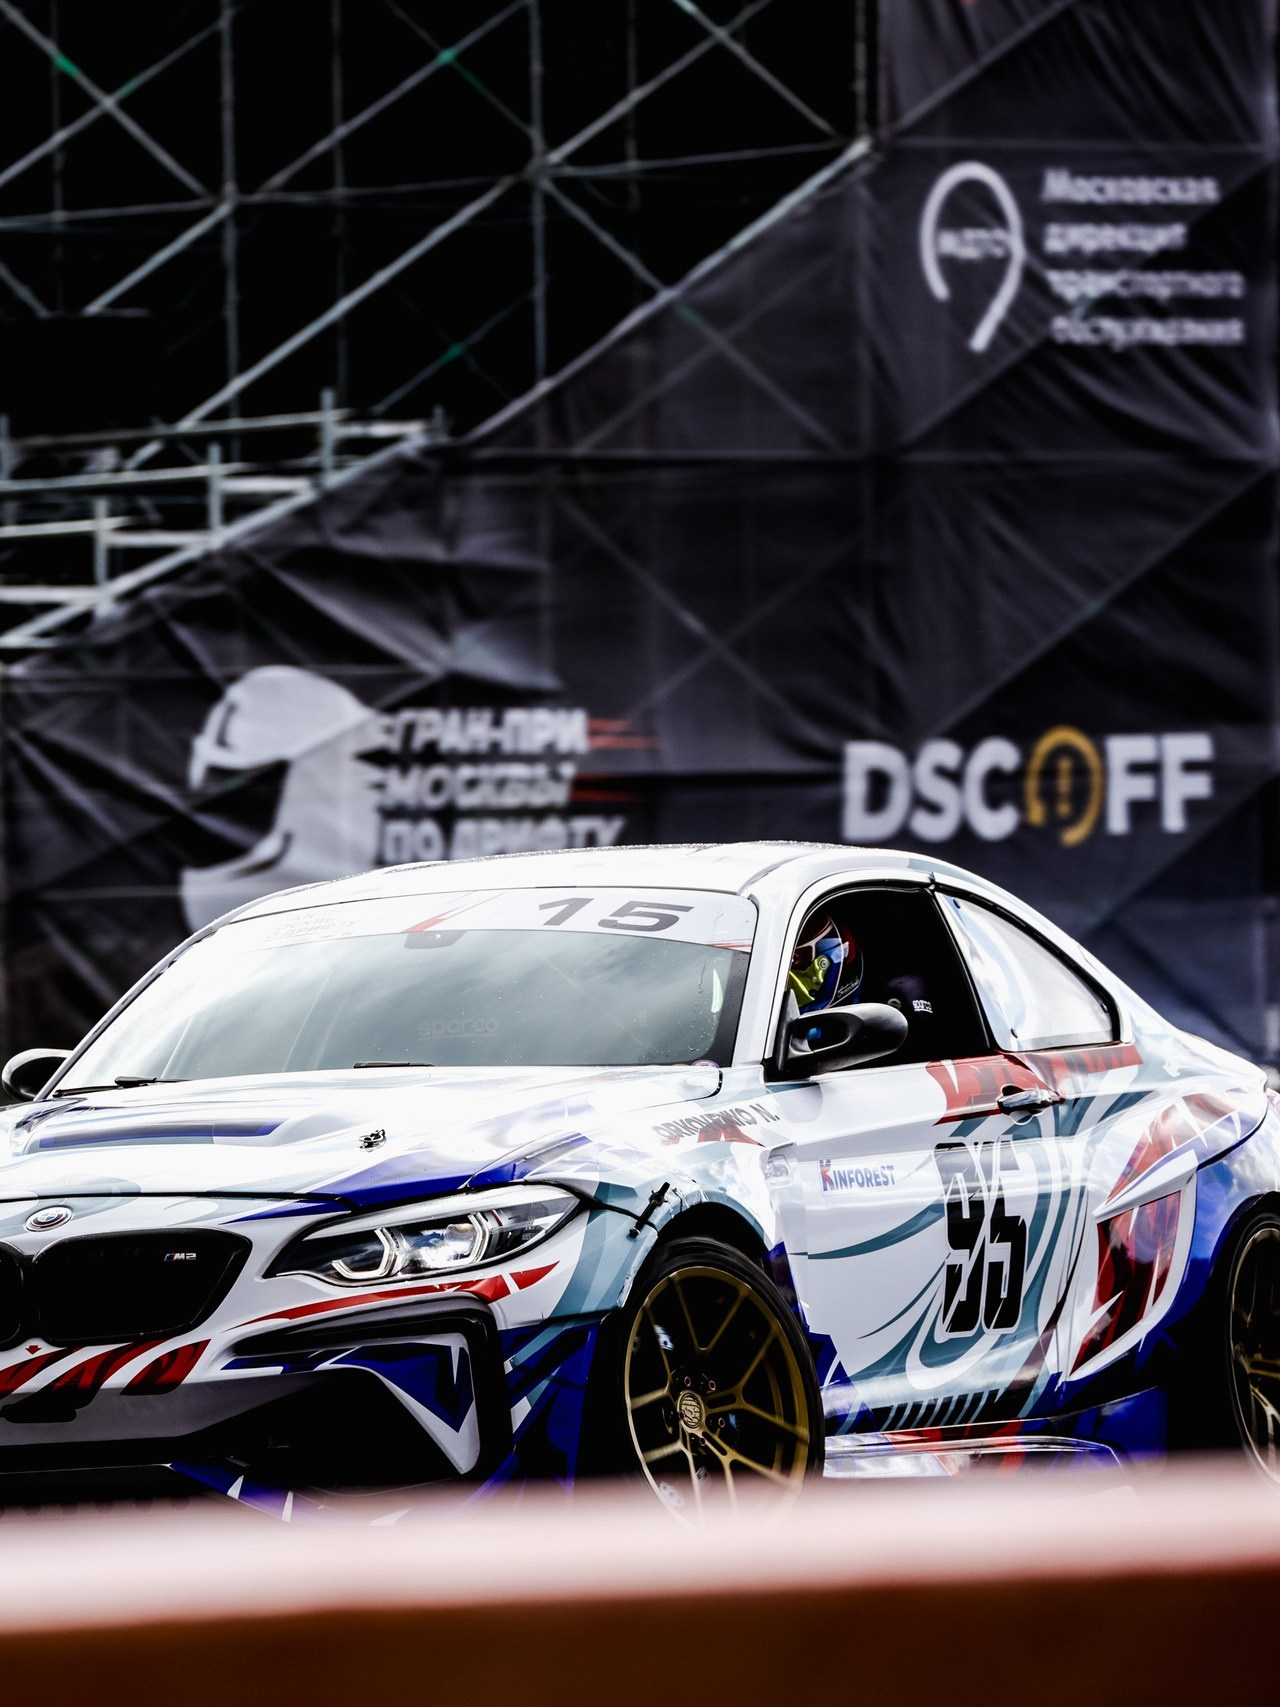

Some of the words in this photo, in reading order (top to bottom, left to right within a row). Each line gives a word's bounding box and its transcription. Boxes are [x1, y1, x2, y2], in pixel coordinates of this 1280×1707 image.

[383, 818, 445, 863] ПО
[538, 896, 694, 932] 15
[749, 1103, 781, 1123] N.
[819, 1159, 896, 1192] KINFOREST
